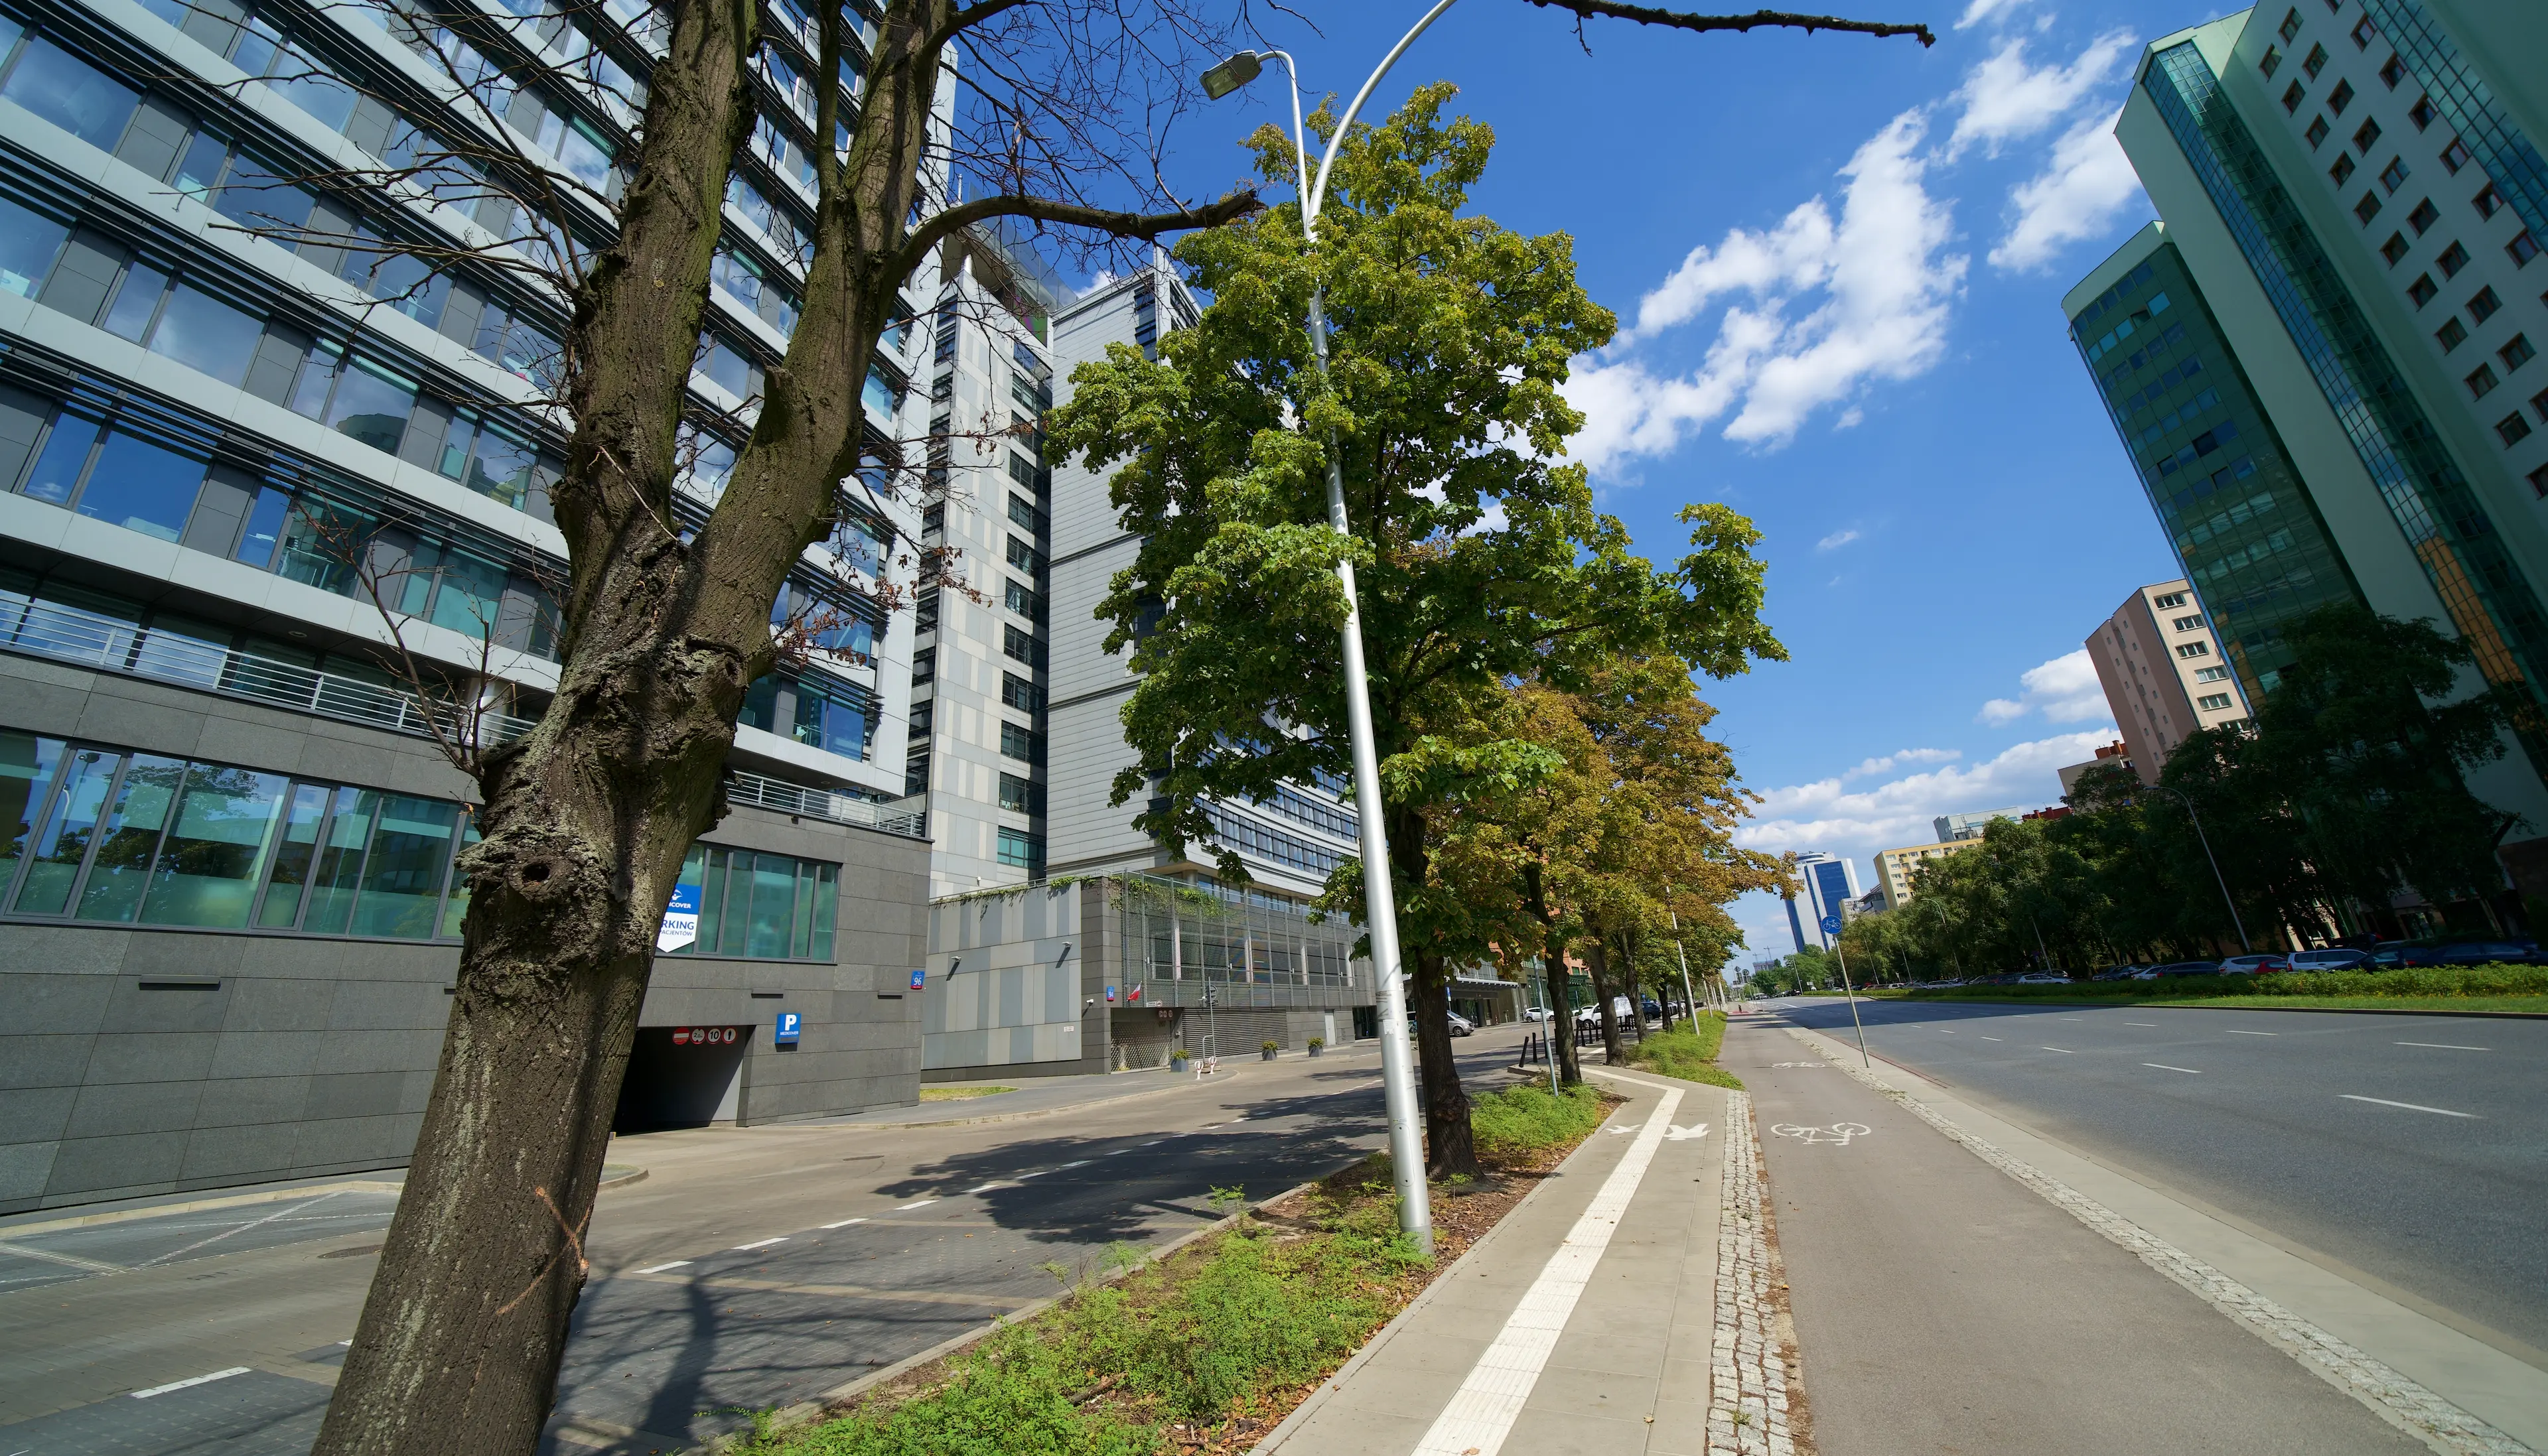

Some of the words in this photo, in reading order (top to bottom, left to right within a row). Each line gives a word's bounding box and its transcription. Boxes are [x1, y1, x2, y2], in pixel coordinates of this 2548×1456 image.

[662, 920, 694, 930] RKING
[914, 977, 922, 986] 96
[784, 1014, 797, 1031] P
[710, 1031, 719, 1039] 10
